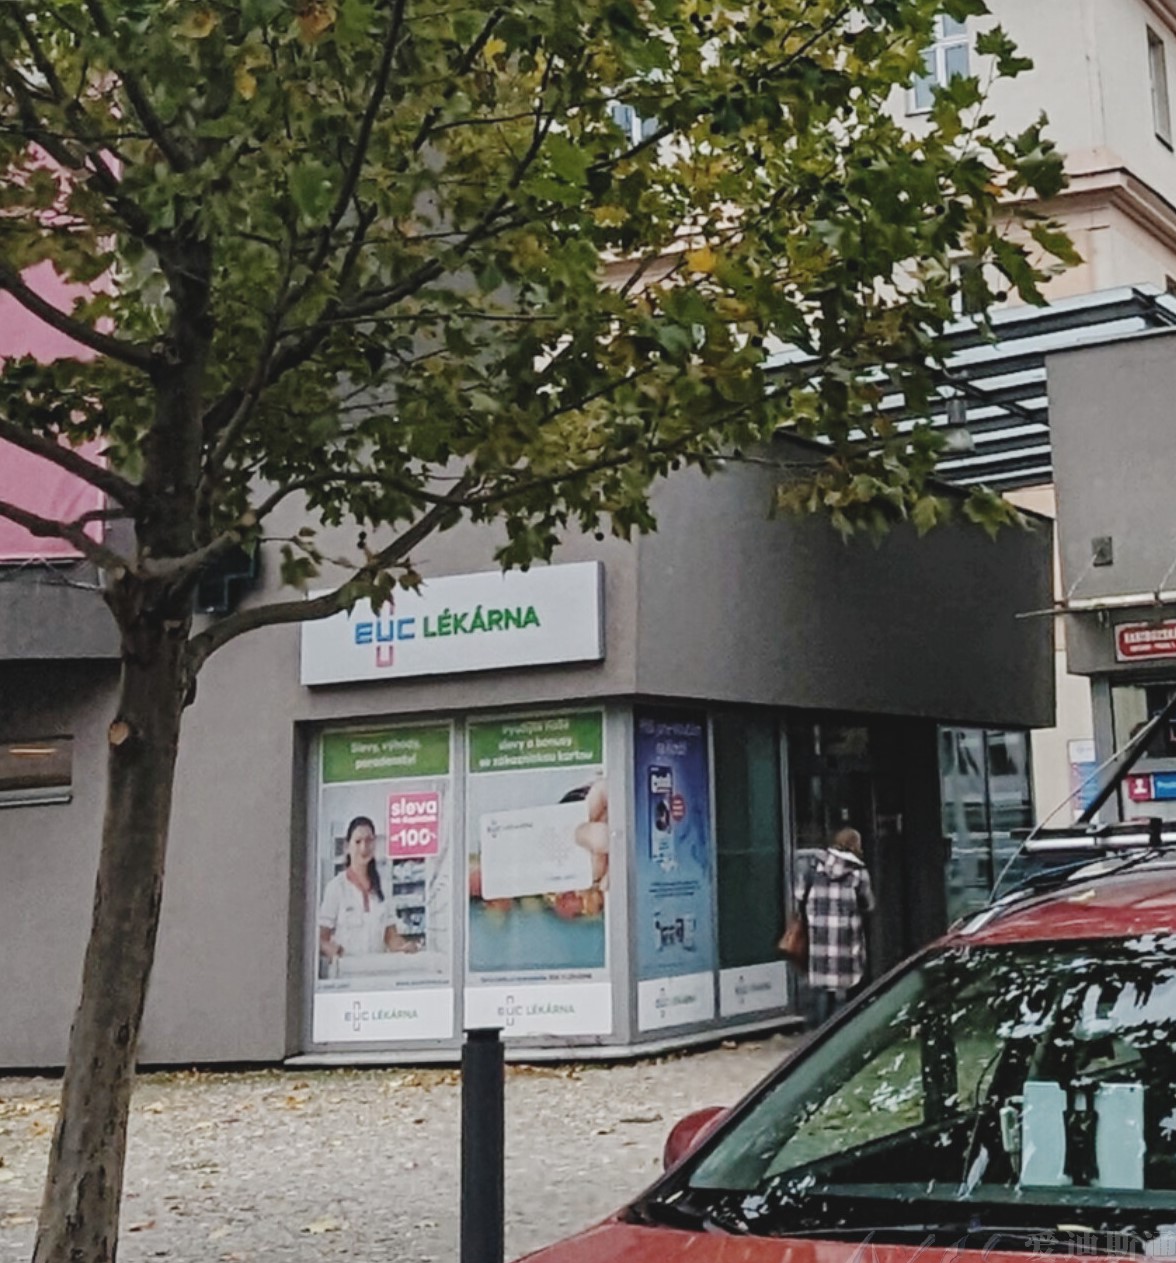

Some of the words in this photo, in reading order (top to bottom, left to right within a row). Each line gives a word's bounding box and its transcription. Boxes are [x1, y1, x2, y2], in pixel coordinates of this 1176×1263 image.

[423, 604, 541, 638] LÉKÁRNA
[391, 797, 437, 816] sleva
[525, 1001, 575, 1016] LÉKÁRNA
